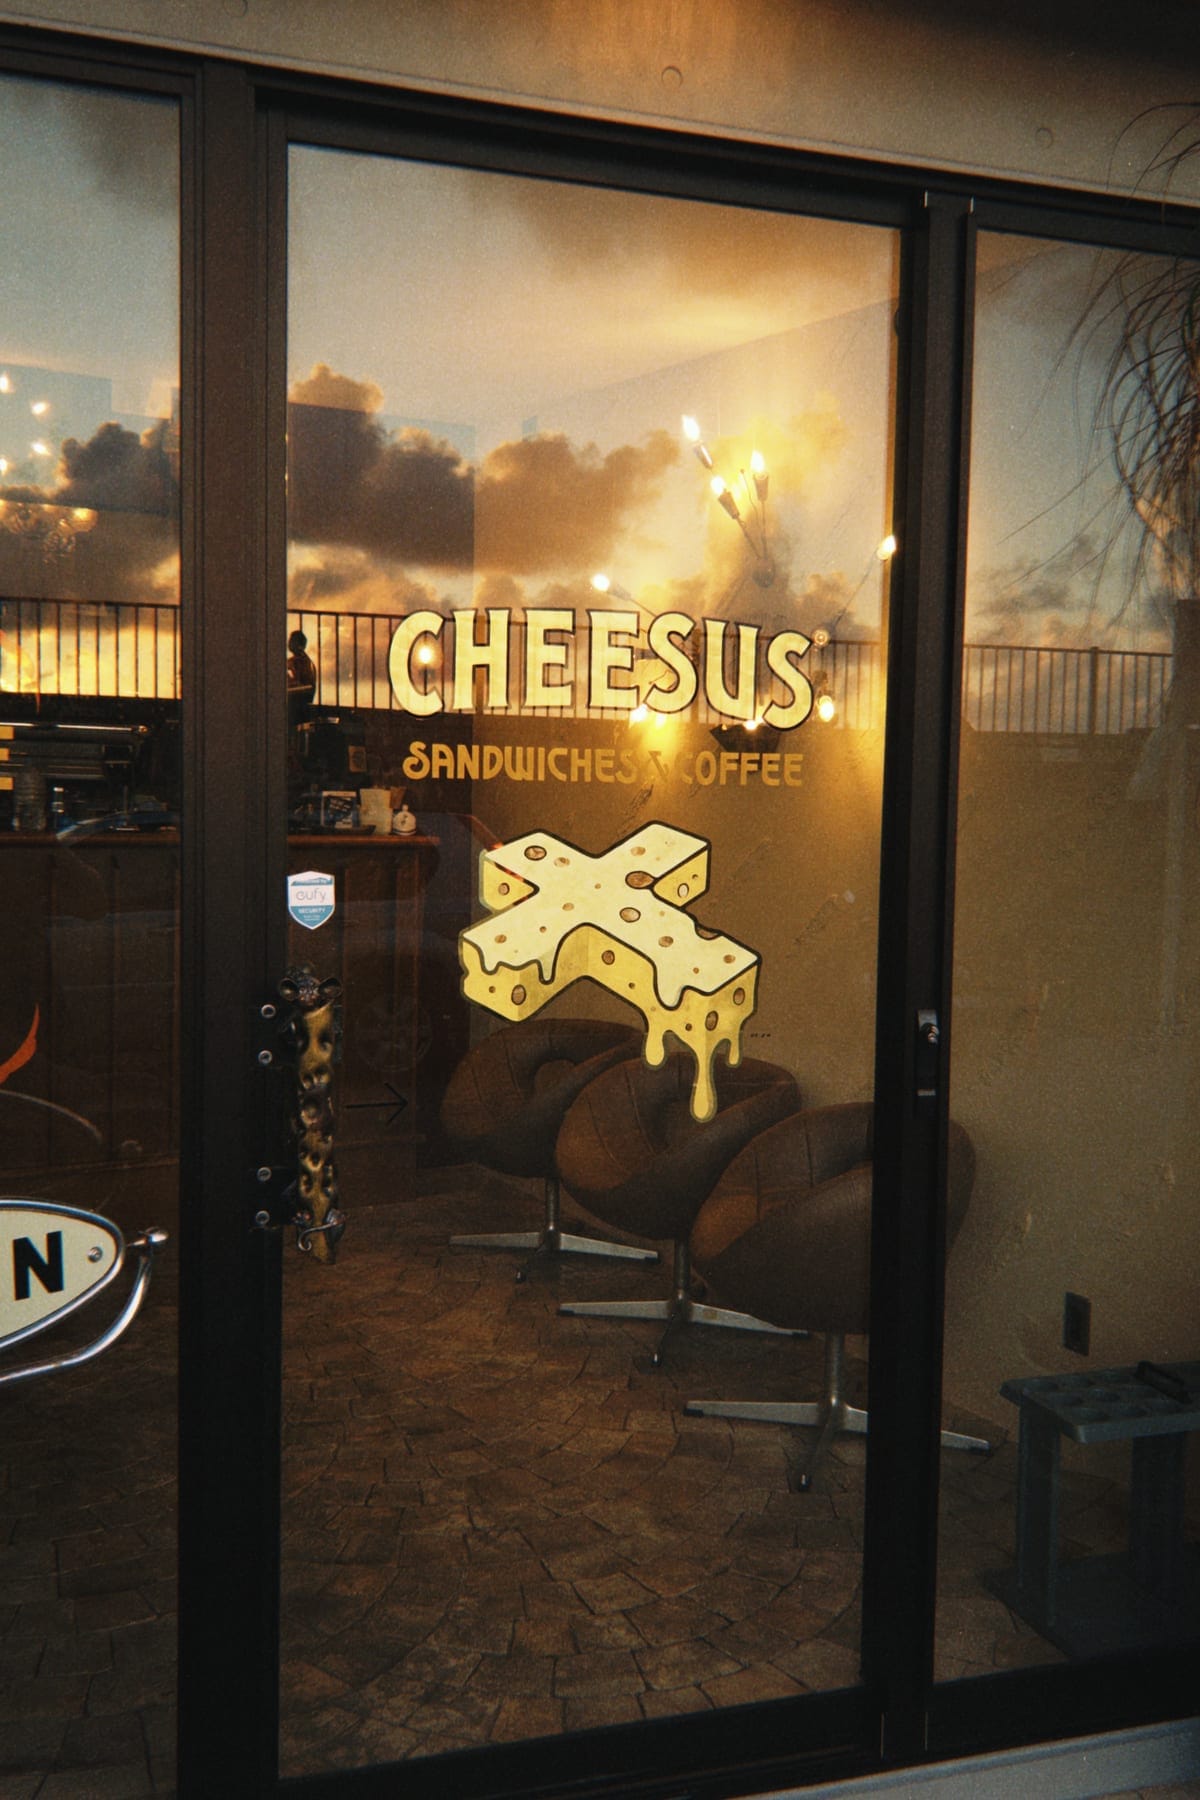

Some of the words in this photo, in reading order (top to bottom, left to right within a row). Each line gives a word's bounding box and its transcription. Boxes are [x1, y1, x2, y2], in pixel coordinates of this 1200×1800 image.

[388, 607, 814, 730] CHEESUS
[402, 741, 638, 784] SANDWICHES
[675, 749, 804, 787] COFFEE
[295, 887, 327, 903] eufy
